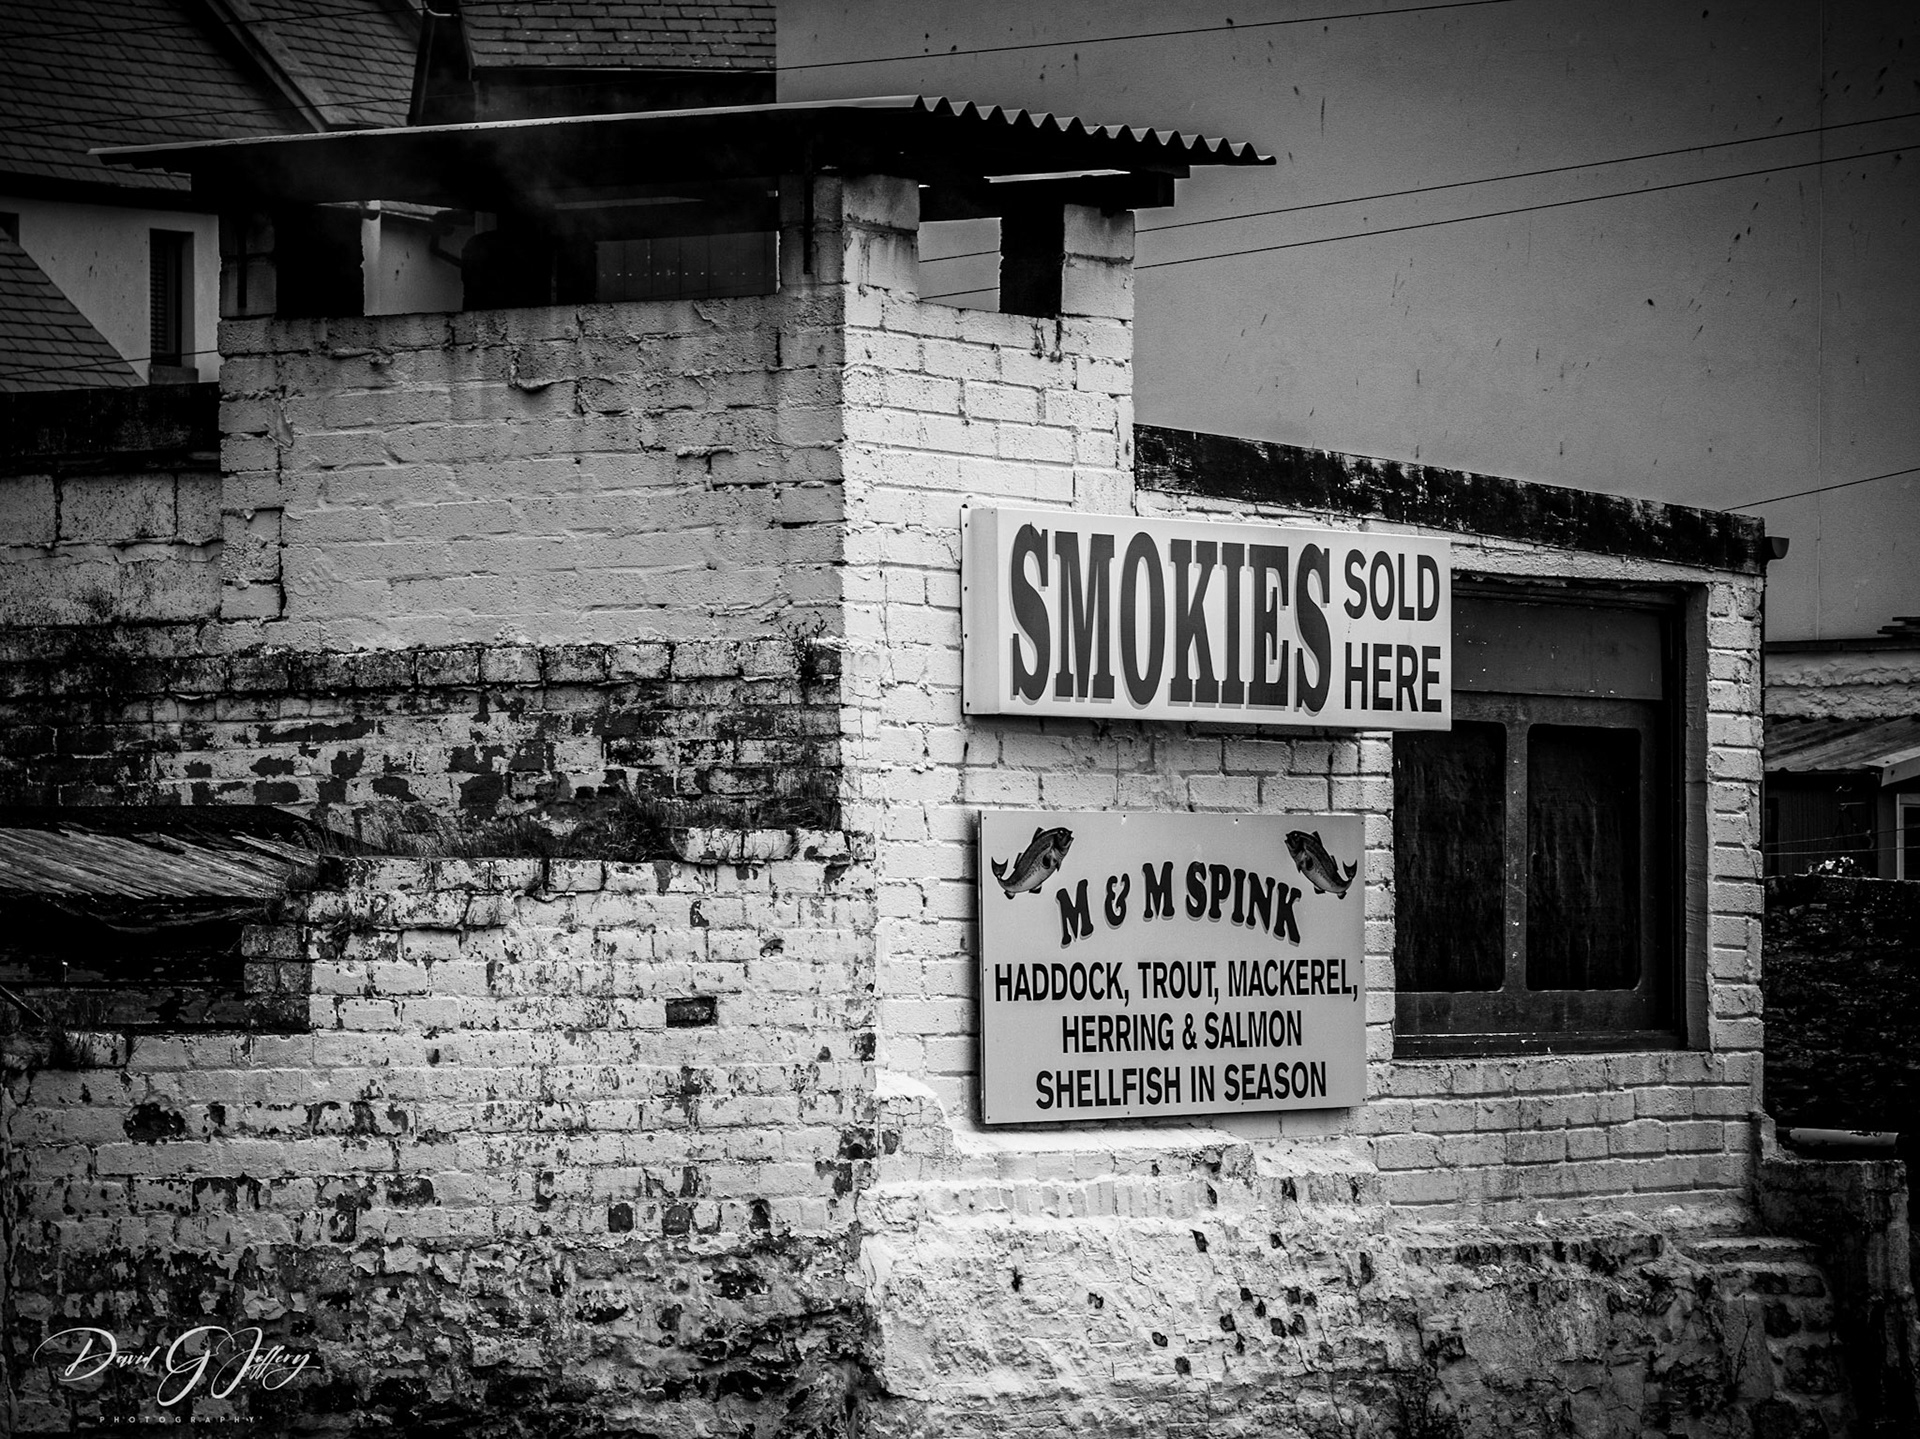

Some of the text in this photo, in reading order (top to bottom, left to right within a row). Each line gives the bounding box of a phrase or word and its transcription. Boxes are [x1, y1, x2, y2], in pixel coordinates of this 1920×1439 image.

[1010, 523, 1331, 717] SMOKIES
[1343, 548, 1440, 622] SOLD
[1344, 641, 1442, 713] HERE
[1056, 861, 1302, 949] M & M SPINK
[995, 958, 1358, 1007] HADDOCK, TROUT, MACKEREL,
[1062, 1010, 1302, 1054] HERRING & SALMON
[1036, 1061, 1327, 1110] SHELLFISH IN SEASON
